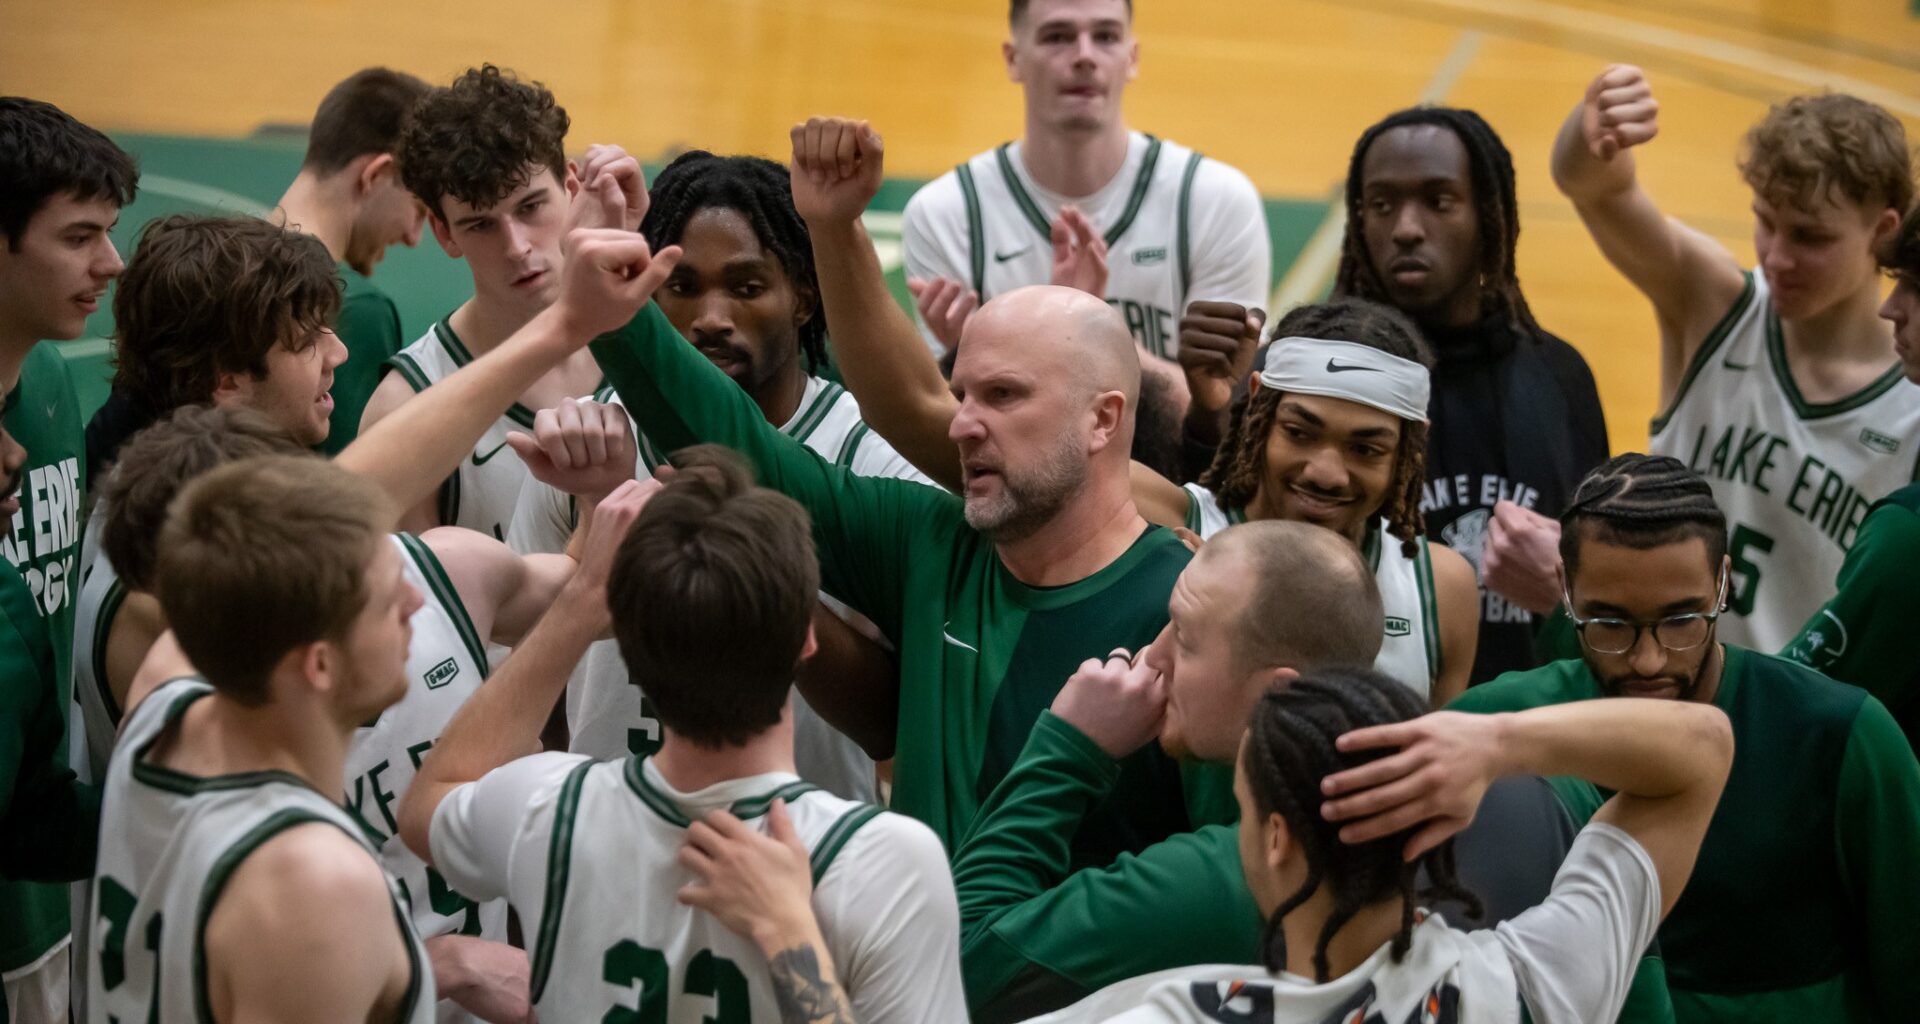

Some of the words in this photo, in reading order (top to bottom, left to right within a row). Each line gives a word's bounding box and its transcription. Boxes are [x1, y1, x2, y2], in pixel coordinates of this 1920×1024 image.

[1105, 298, 1179, 362] RIE
[29, 456, 80, 558] ERIE
[1418, 475, 1469, 513] AKE
[1689, 423, 1789, 496] LAKE
[1785, 453, 1871, 553] ERIE
[20, 554, 73, 618] RGY
[1729, 522, 1775, 617] 5
[428, 661, 456, 686] G-MAC
